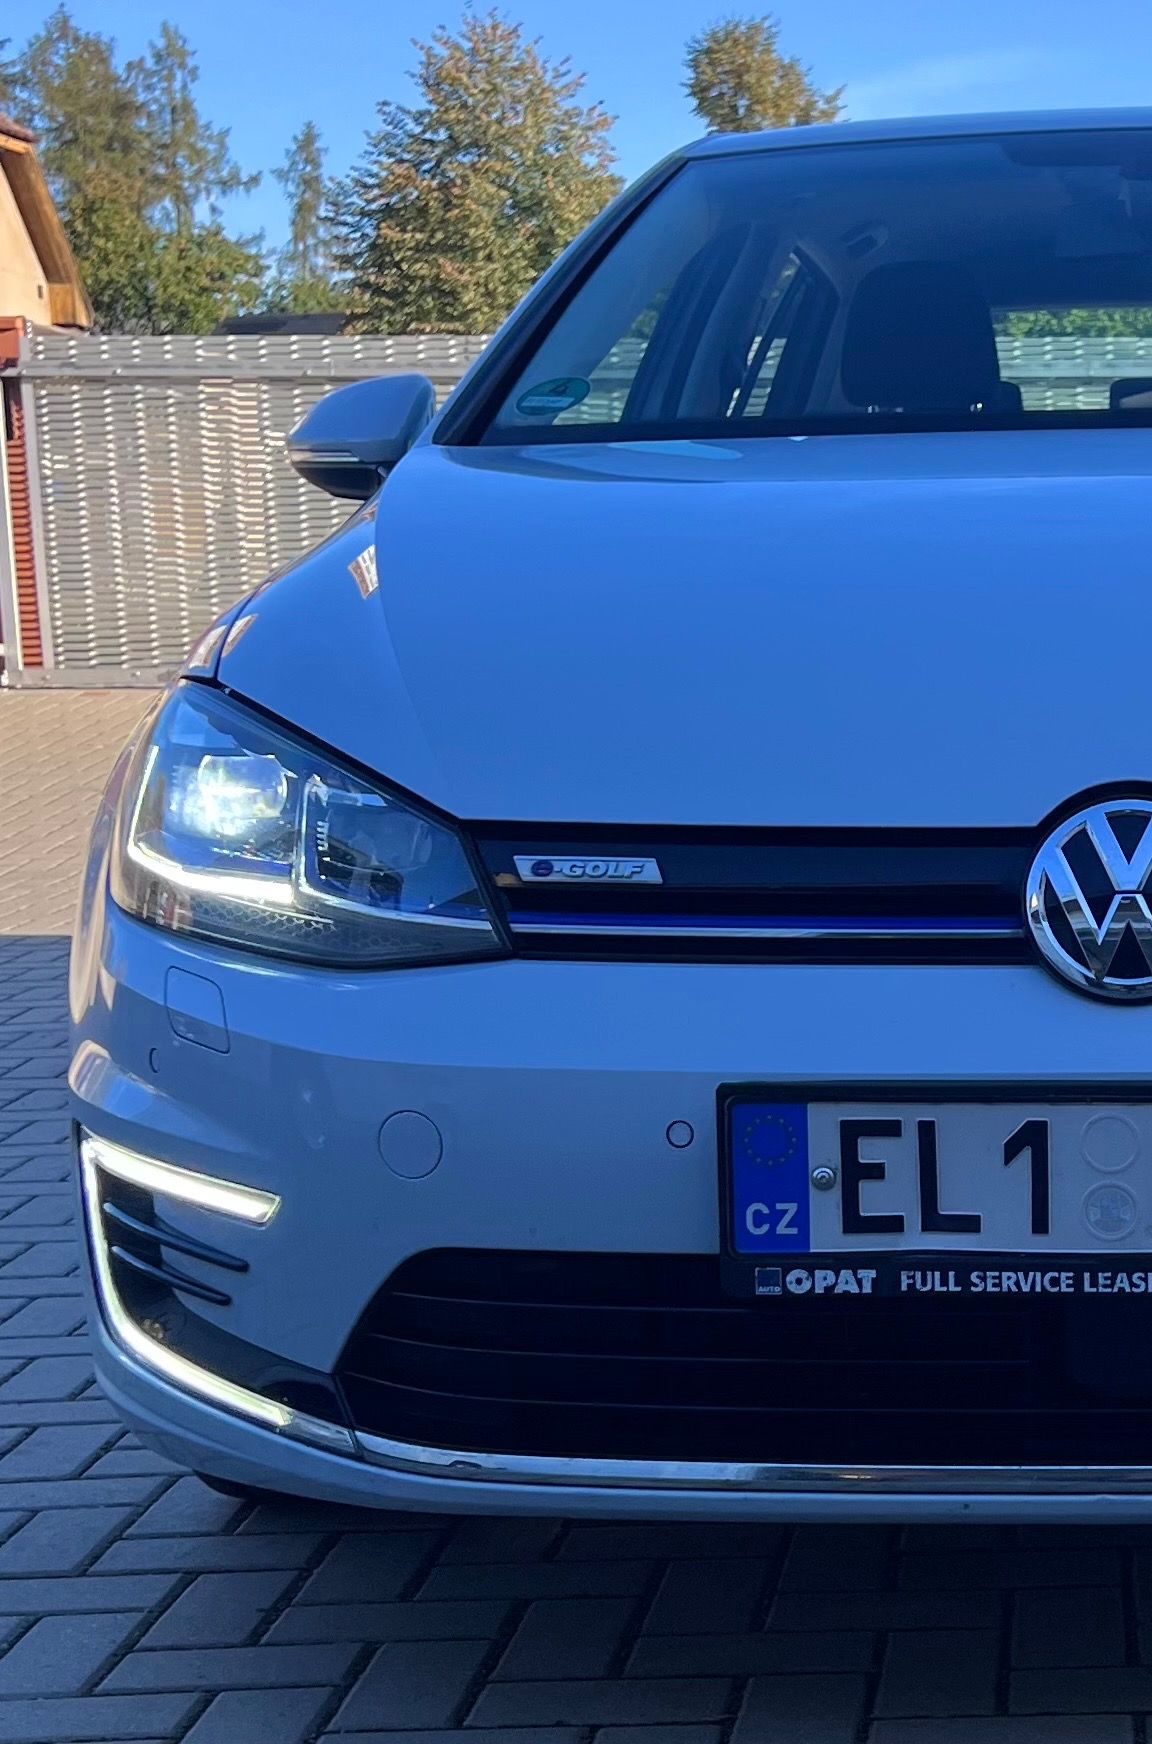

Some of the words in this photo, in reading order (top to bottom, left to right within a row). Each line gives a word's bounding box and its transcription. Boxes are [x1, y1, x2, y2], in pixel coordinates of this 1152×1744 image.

[839, 1118, 1050, 1235] EL1
[745, 1203, 798, 1235] CZ
[785, 1268, 877, 1295] OPAT
[900, 1270, 962, 1293] FULL
[969, 1270, 1075, 1293] SERVICE
